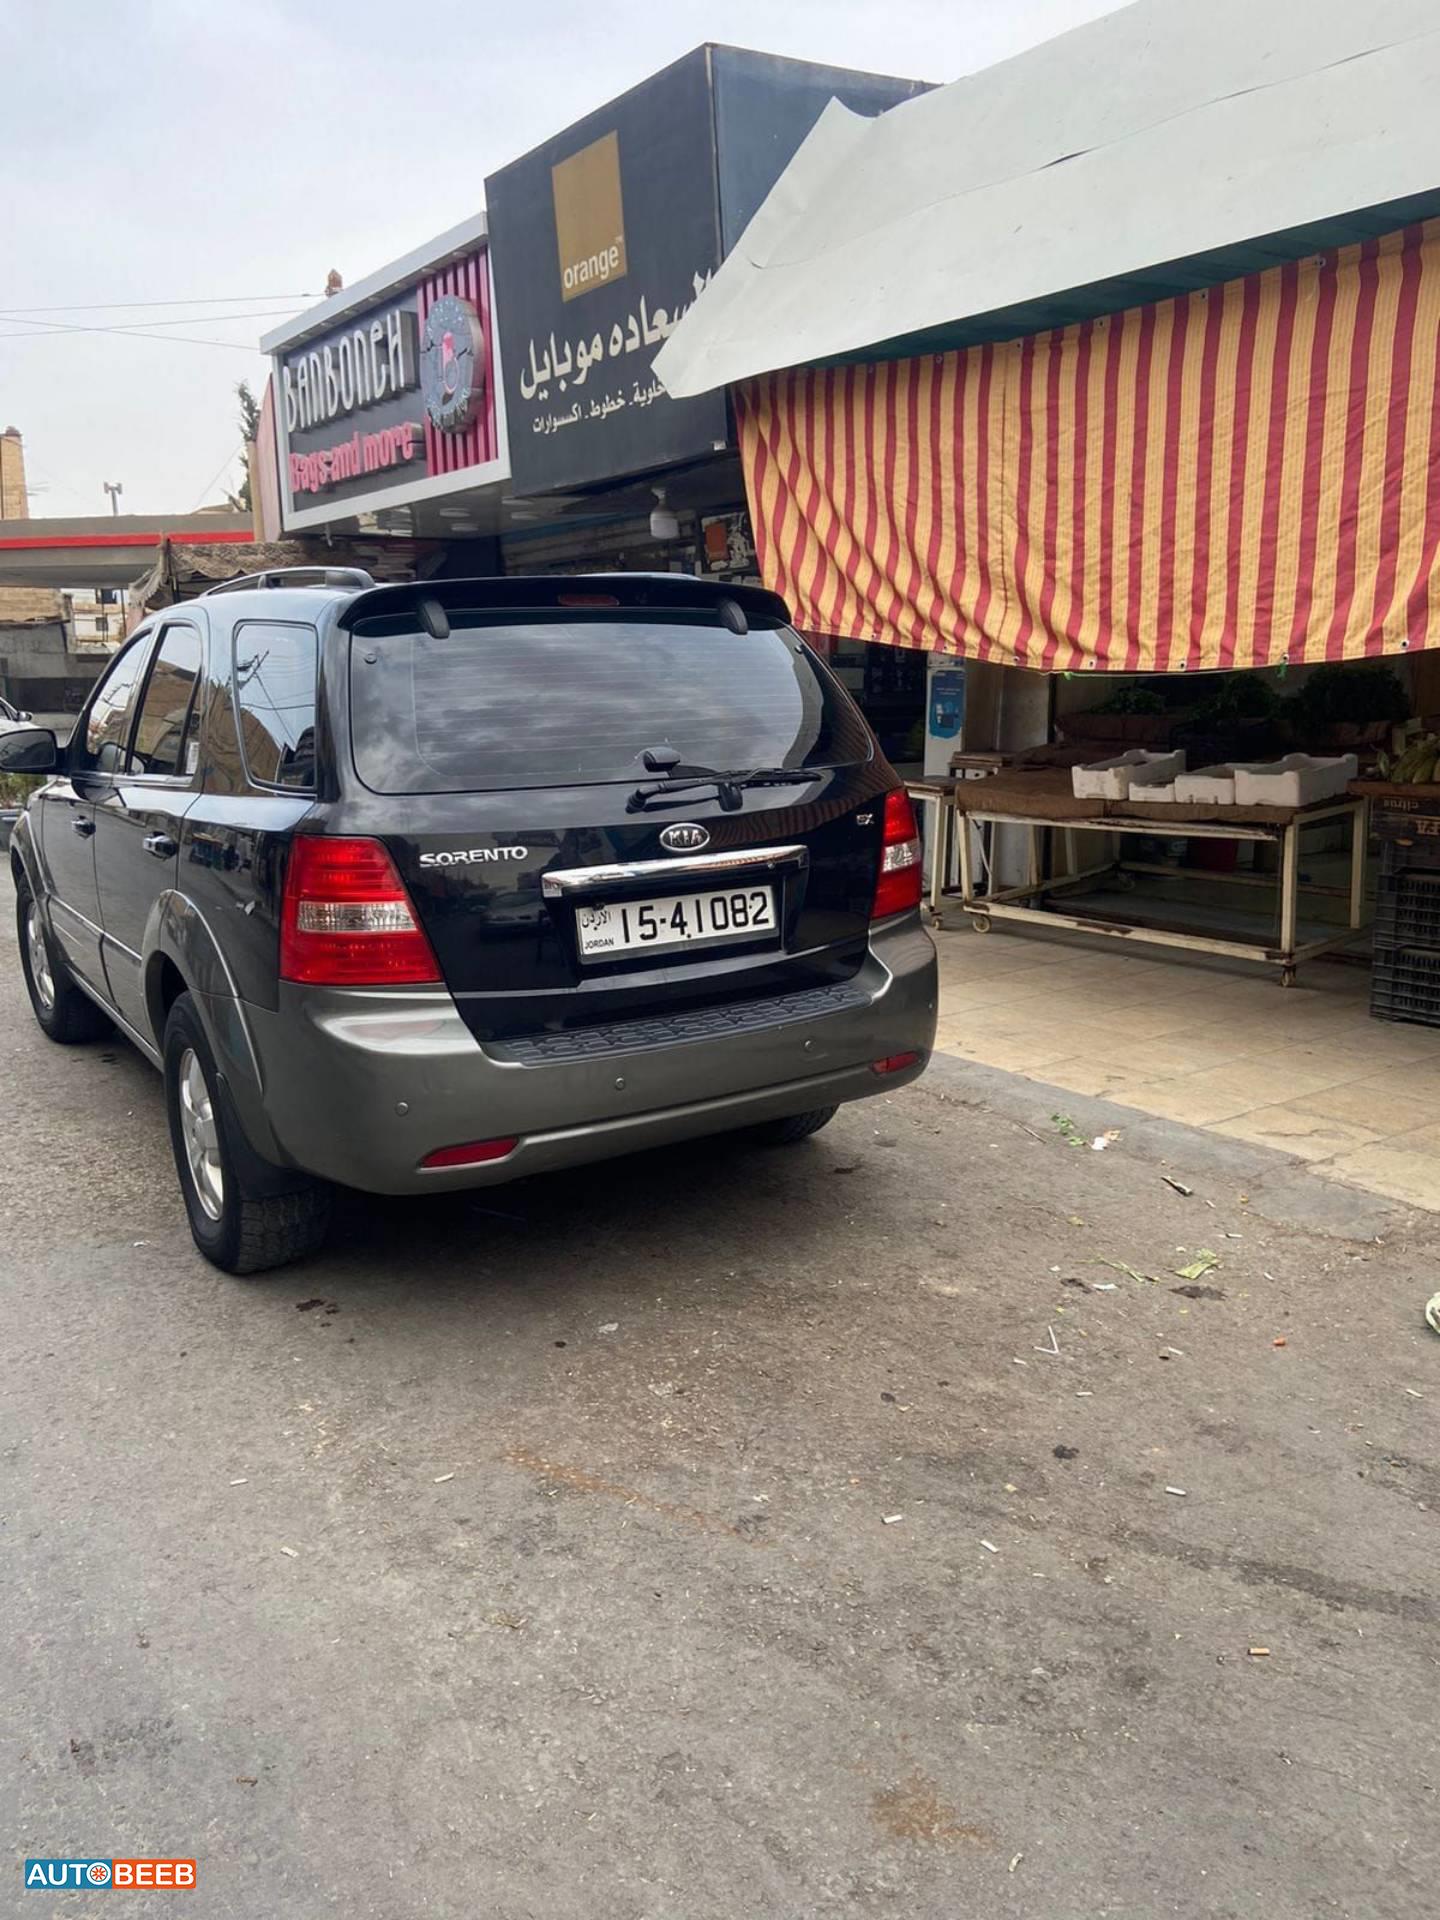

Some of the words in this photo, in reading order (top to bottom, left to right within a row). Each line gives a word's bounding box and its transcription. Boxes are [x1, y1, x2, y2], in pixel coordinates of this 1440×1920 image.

[563, 245, 619, 289] orange
[519, 331, 604, 400] موبايل
[330, 431, 359, 481] and
[363, 421, 414, 472] more
[419, 845, 529, 868] SORENTO
[668, 828, 704, 846] KIA
[621, 891, 769, 944] 15-41082
[584, 938, 615, 950] JORDAN
